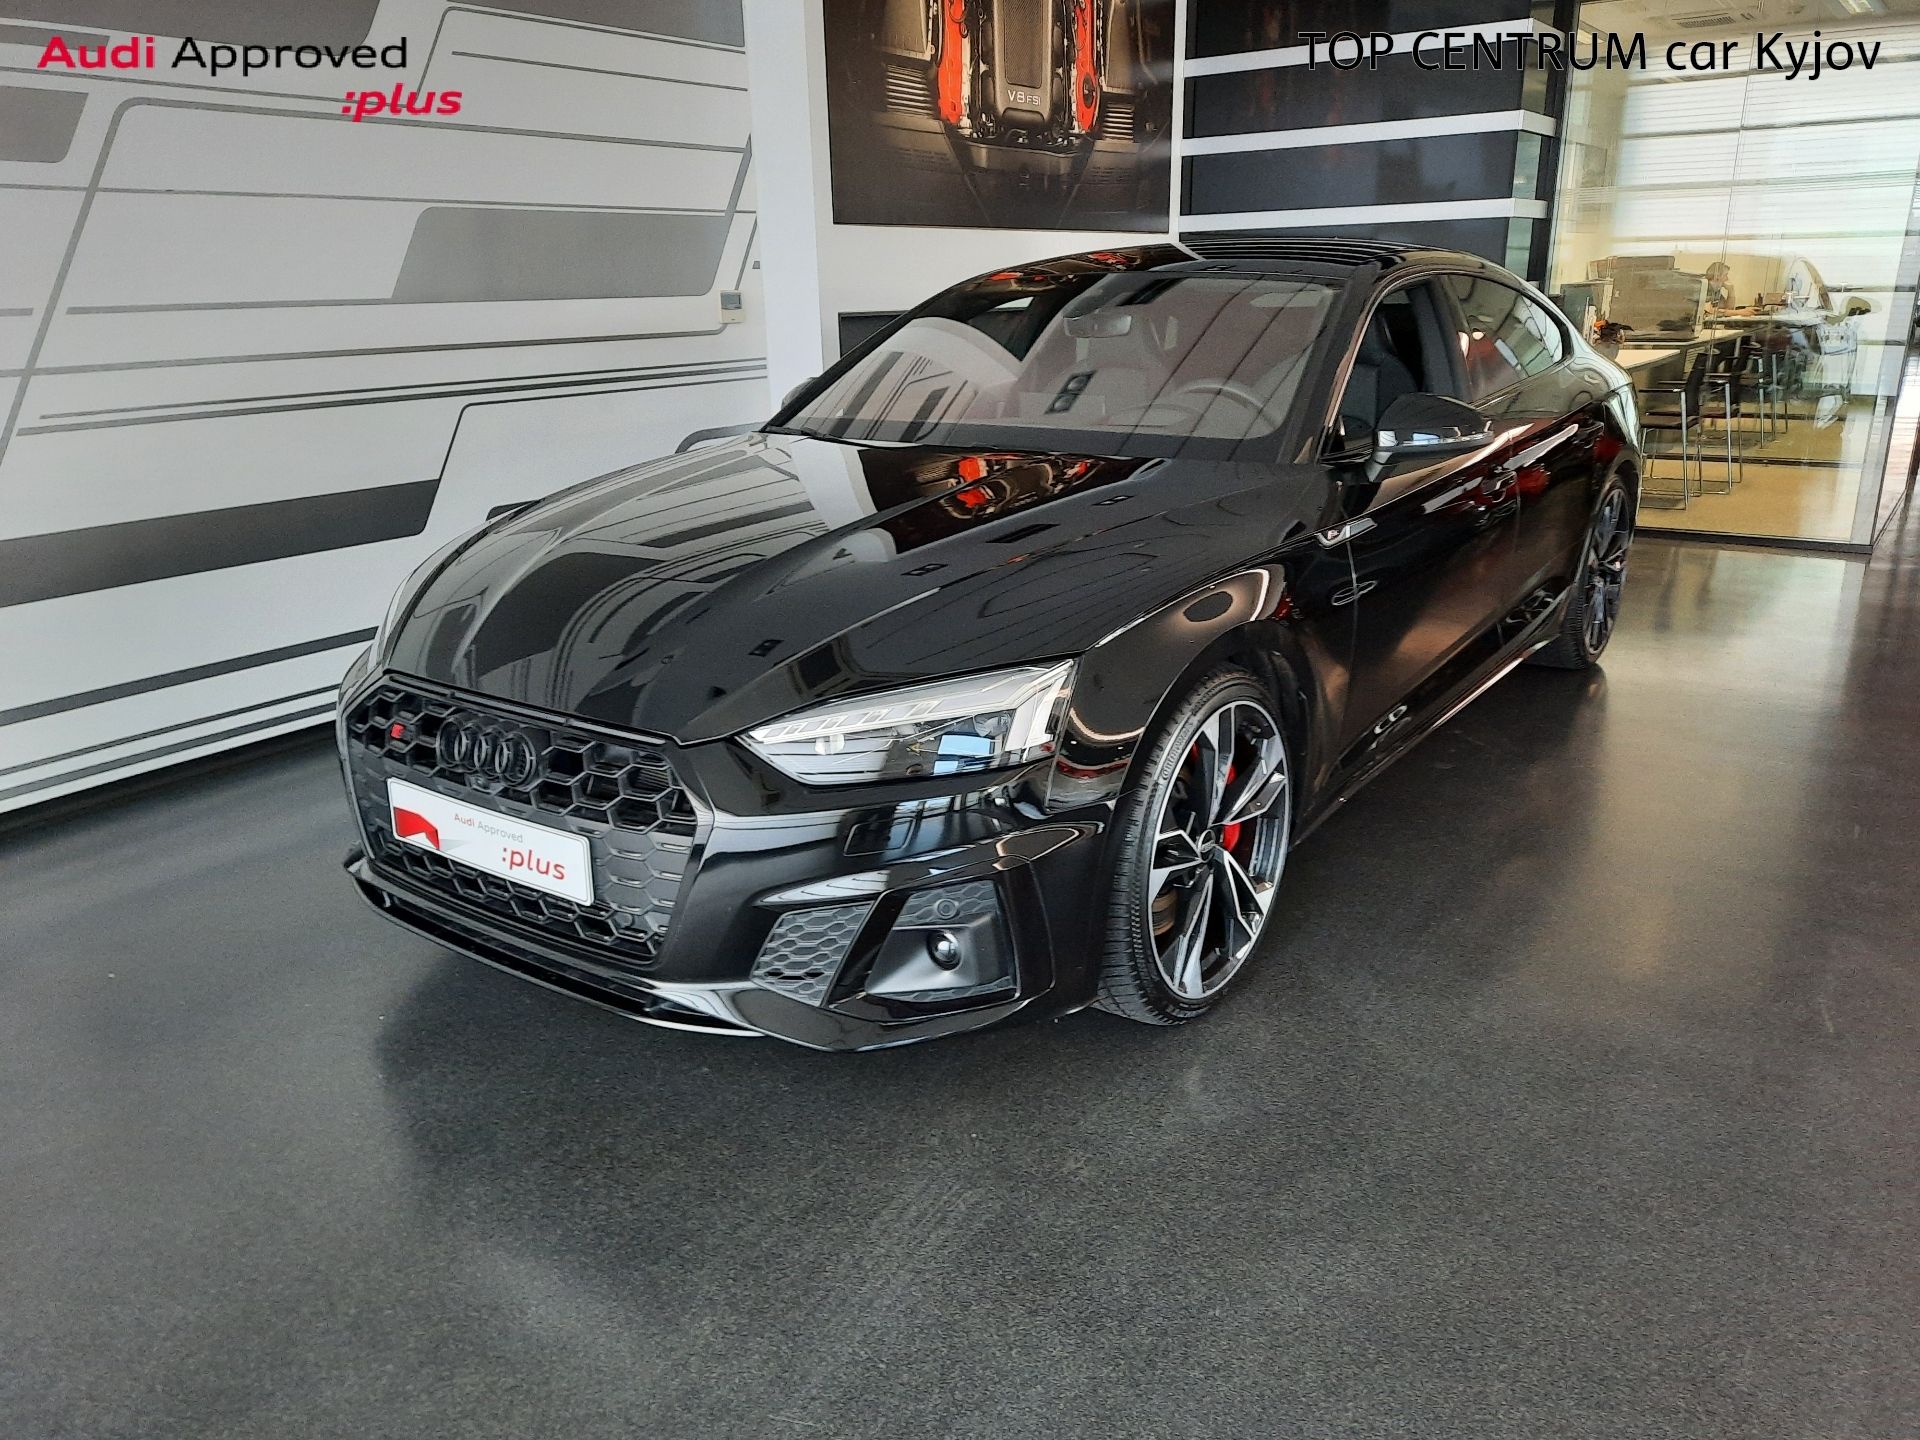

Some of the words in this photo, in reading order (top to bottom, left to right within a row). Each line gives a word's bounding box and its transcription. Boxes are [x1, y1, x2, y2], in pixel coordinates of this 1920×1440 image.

[1007, 89, 1025, 103] V8
[454, 813, 475, 828] Audi
[477, 821, 524, 843] Approved
